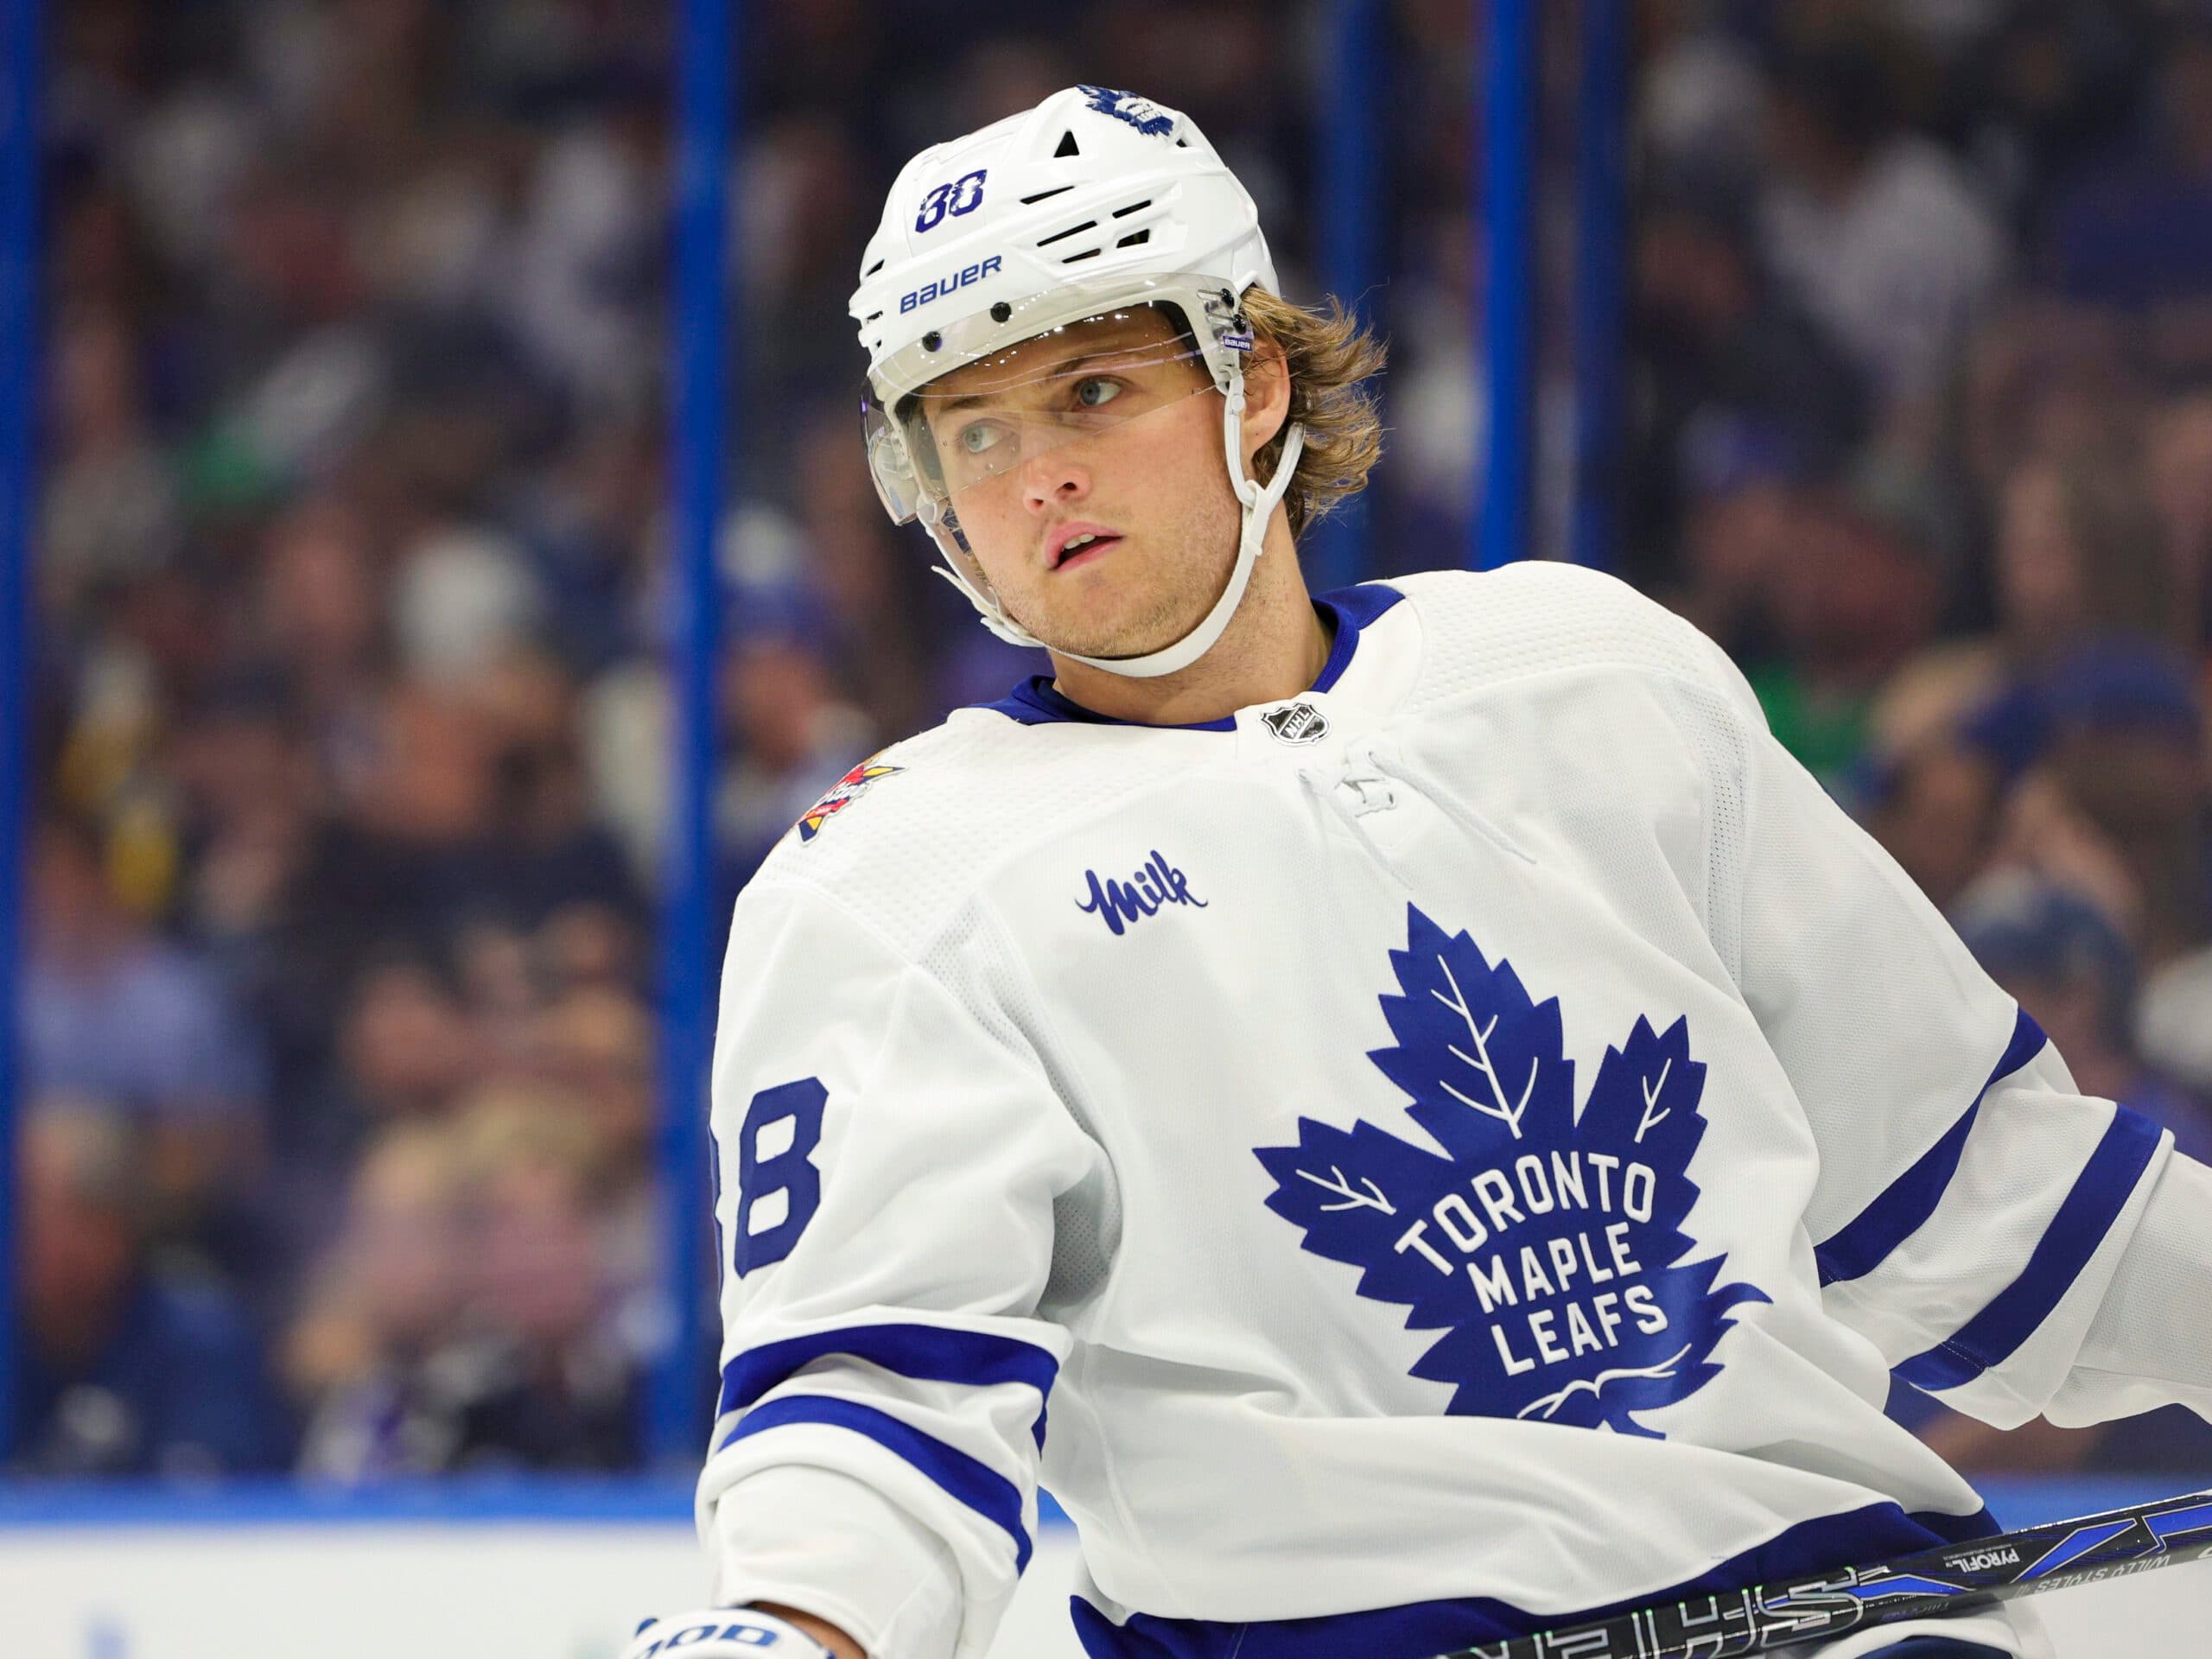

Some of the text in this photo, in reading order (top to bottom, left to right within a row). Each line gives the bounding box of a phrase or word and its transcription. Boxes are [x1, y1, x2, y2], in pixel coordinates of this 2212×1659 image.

[1284, 709, 1310, 739] NHL
[1074, 849, 1208, 935] Milk
[1394, 1150, 1656, 1276] TORONTO
[1467, 1222, 1642, 1313] MAPLE
[1491, 1285, 1669, 1376] LEAFS
[2034, 1567, 2108, 1594] STYLES
[2110, 1554, 2171, 1580] WILLY
